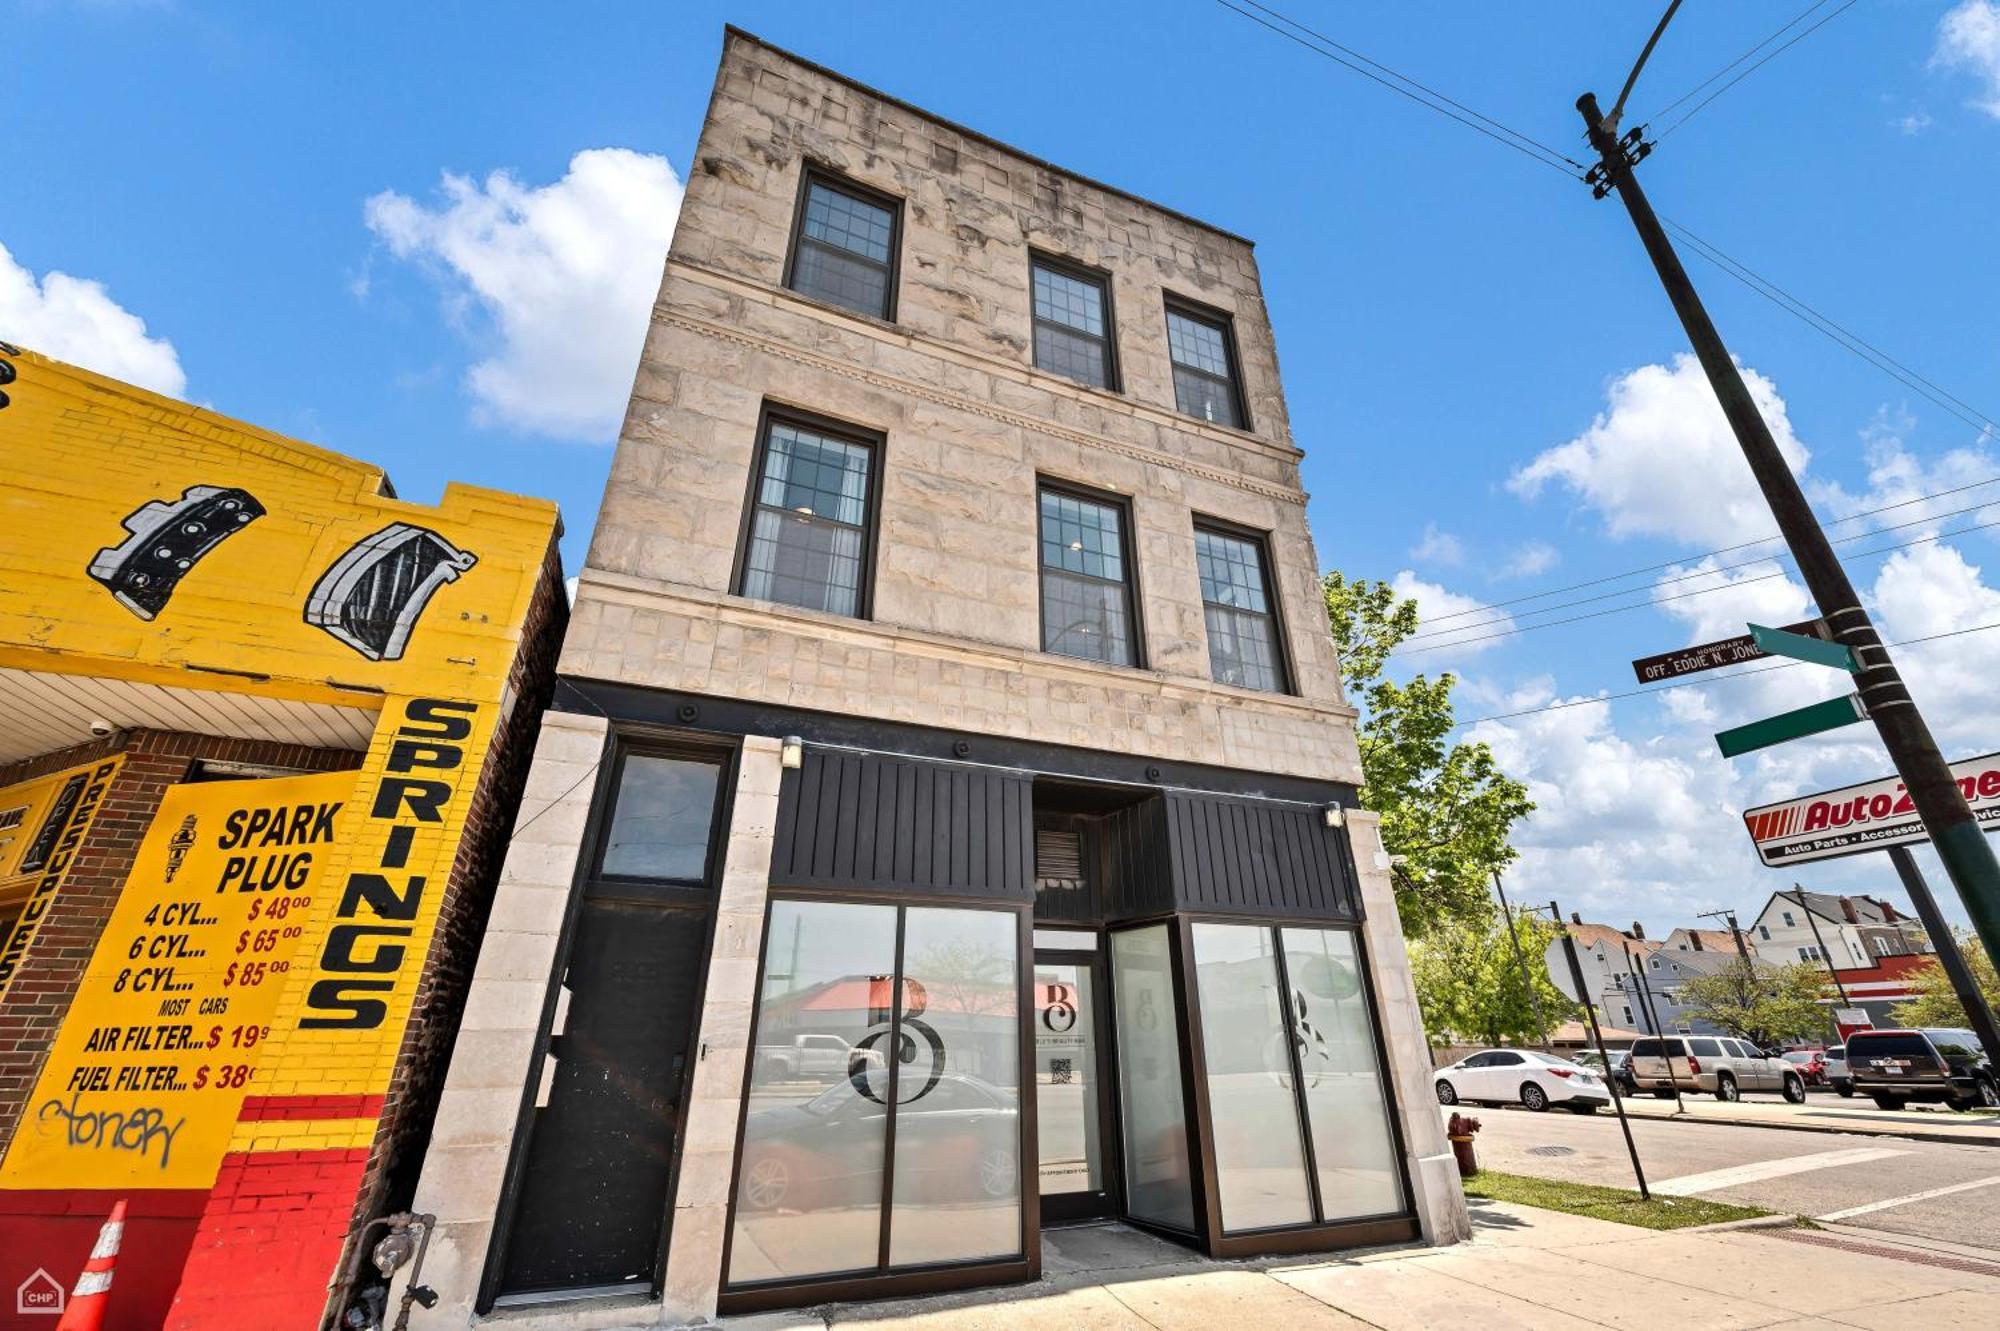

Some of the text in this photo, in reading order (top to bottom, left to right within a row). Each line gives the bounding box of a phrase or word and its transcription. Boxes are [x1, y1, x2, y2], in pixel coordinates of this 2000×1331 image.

[1645, 643, 1761, 679] OFF. EDDIE N. JONE
[1697, 640, 1744, 655] HONORARY
[1803, 770, 2000, 832] AutoZne
[218, 801, 344, 850] SPARK
[1784, 844, 1812, 856] Auto
[1814, 837, 1848, 850] Parts
[1860, 823, 1923, 841] Accessor
[0, 761, 116, 991] PRESUPUES
[216, 852, 312, 894] PLUG
[298, 697, 479, 1030] SPRINGS
[143, 903, 161, 927] 4
[128, 935, 146, 960] 6
[113, 968, 131, 993] 8
[157, 997, 229, 1017] MOST CARS
[84, 1027, 121, 1052] AIR
[66, 1066, 112, 1091] FUEL
